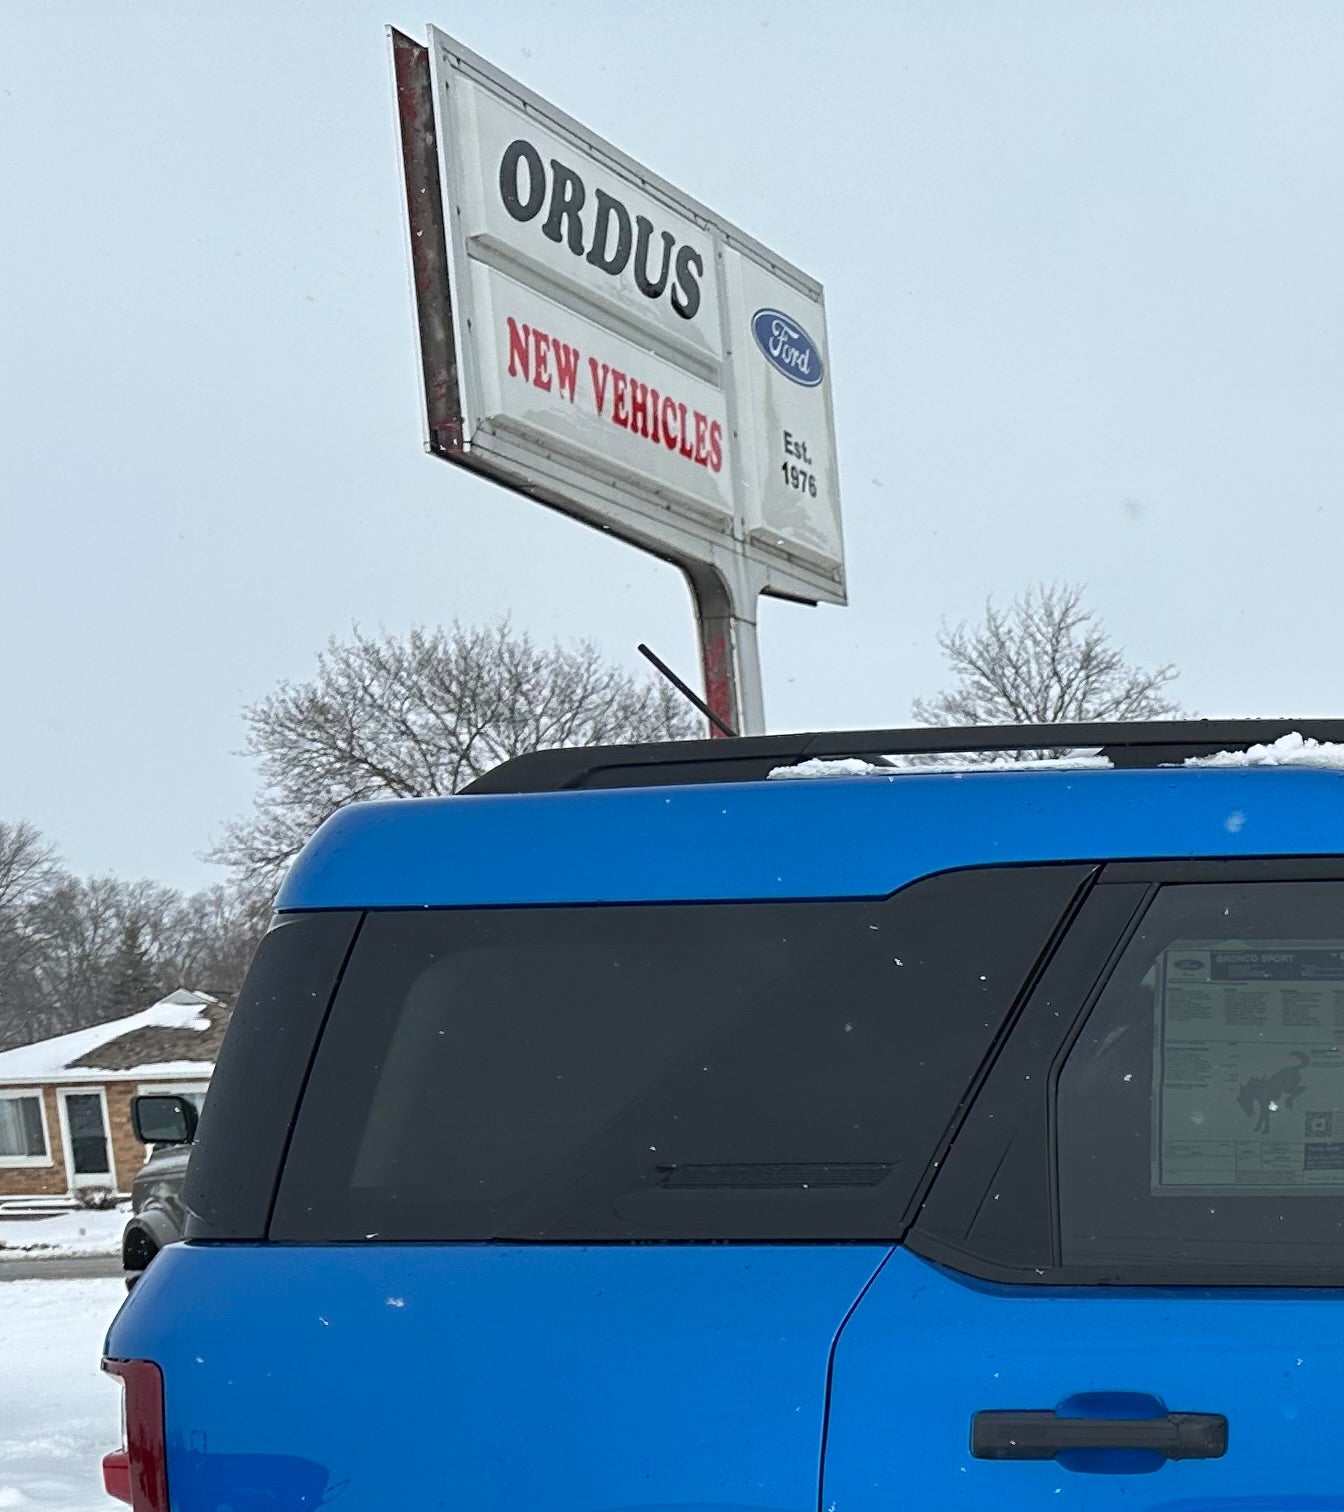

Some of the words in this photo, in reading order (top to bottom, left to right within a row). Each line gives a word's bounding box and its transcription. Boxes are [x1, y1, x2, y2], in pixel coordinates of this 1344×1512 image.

[499, 139, 703, 320] ORDUS
[506, 316, 580, 404] NEW
[588, 357, 723, 473] VEHICLES
[781, 461, 817, 498] 1976
[783, 430, 812, 465] Est.
